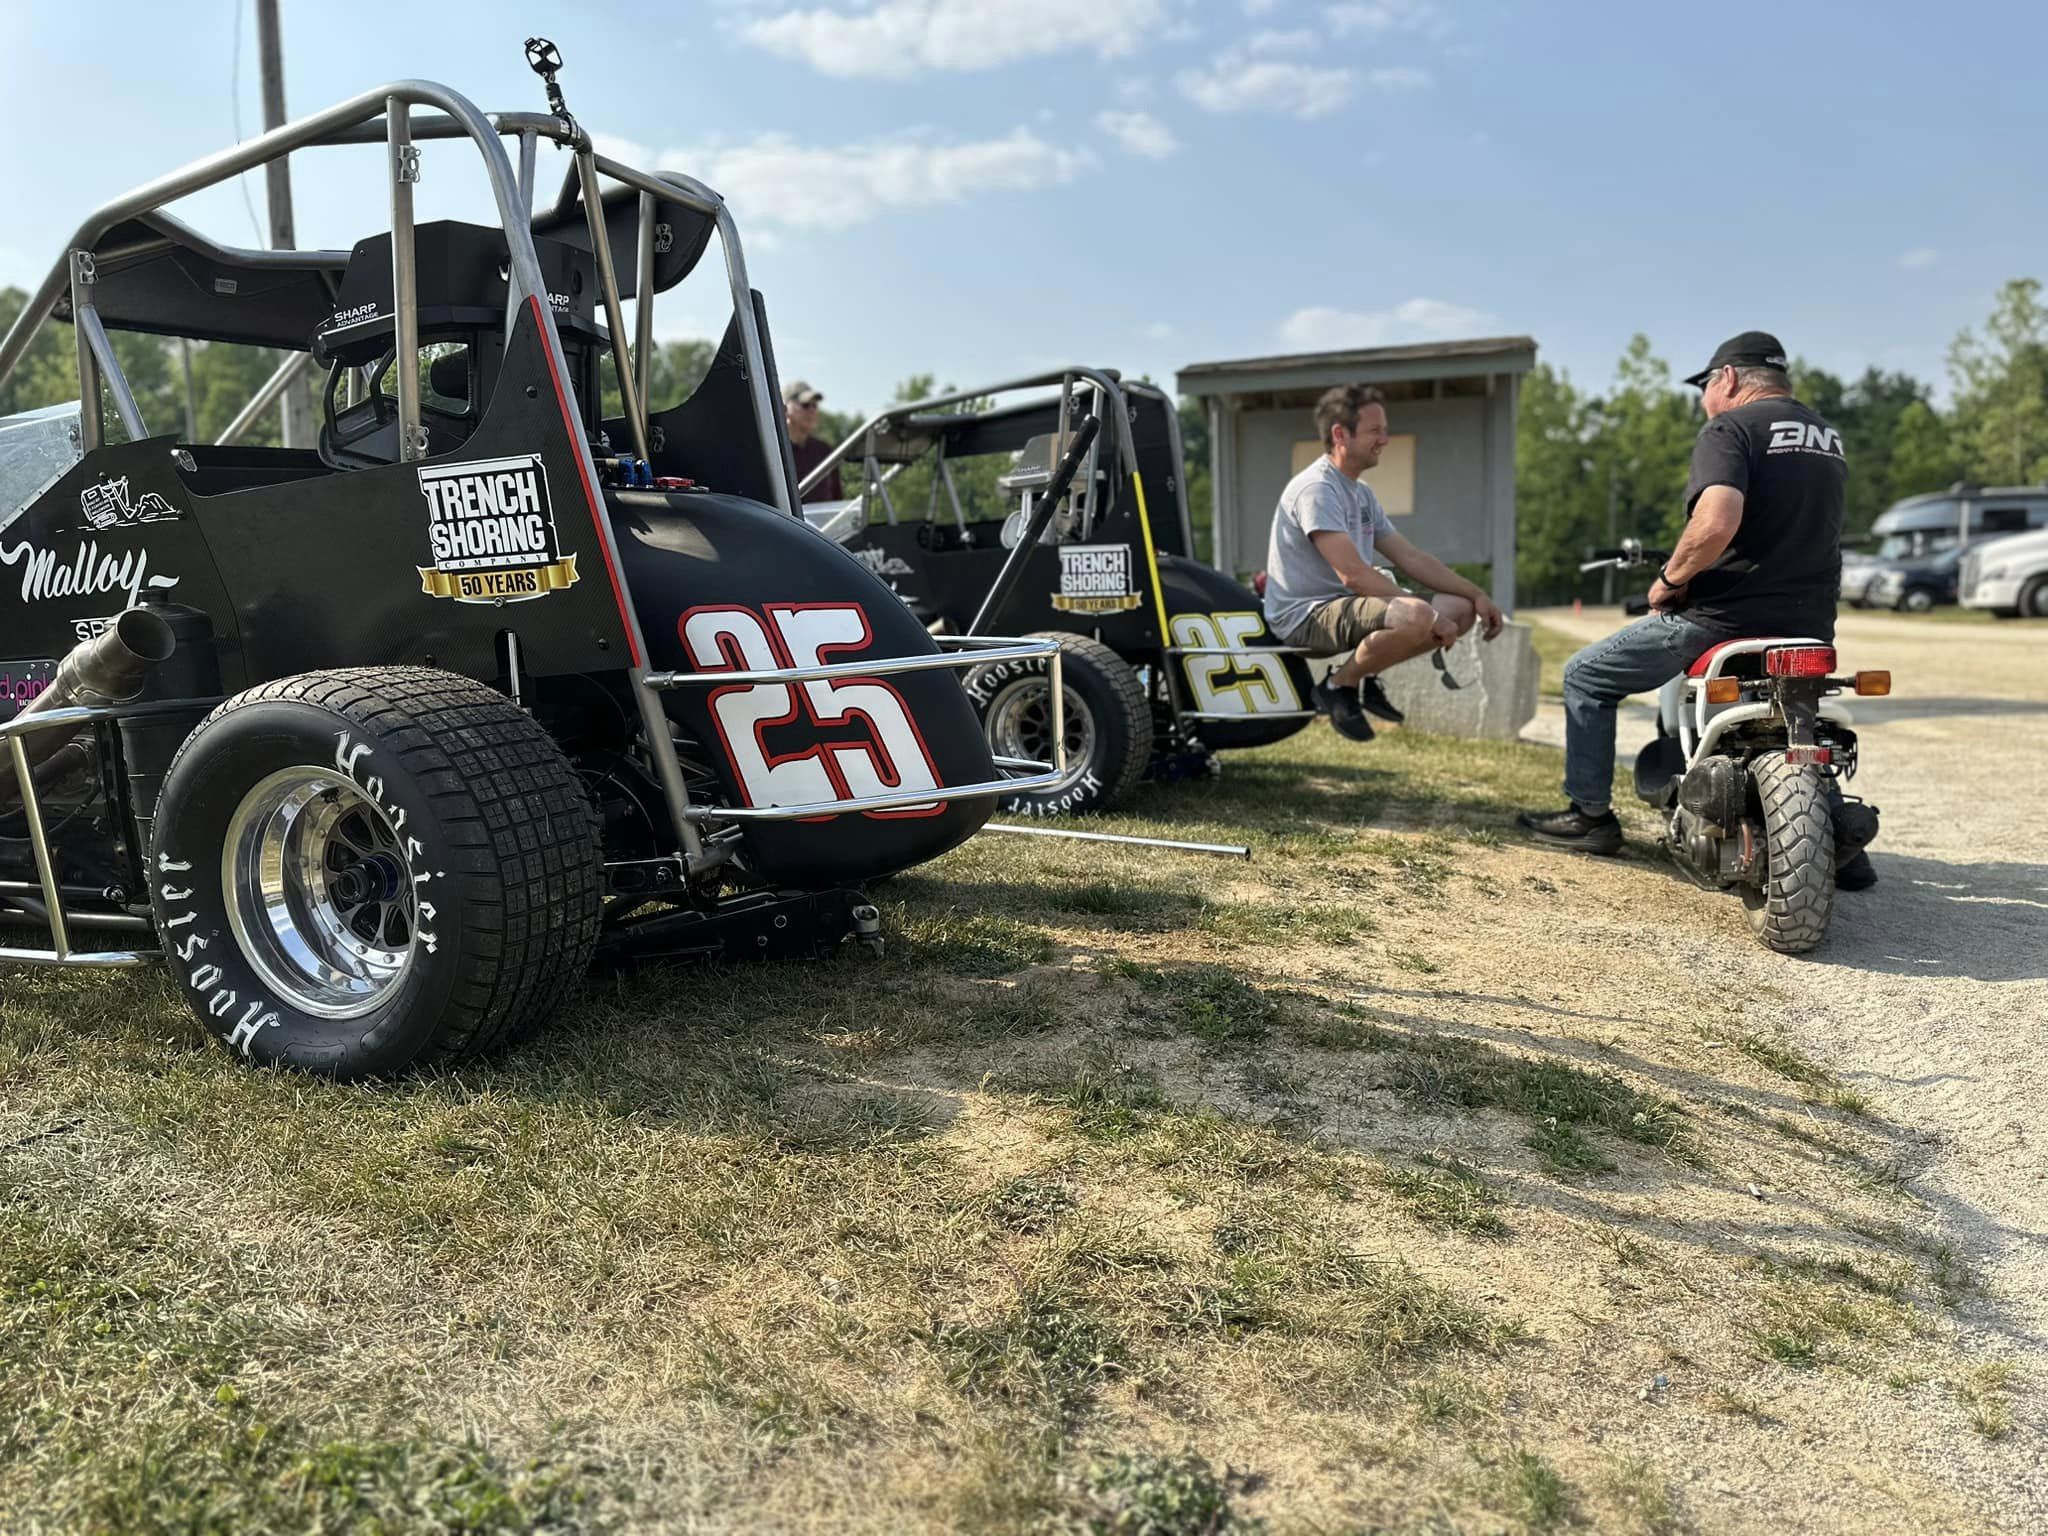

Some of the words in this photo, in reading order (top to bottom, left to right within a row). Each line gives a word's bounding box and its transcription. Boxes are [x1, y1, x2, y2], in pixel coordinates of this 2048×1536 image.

[334, 303, 377, 322] SHARP
[336, 311, 379, 328] ADVANTAGE
[423, 471, 541, 521] TRENCH
[432, 514, 546, 559] SHORING
[0, 540, 147, 609] Malloy
[444, 553, 543, 569] COMPANY
[1060, 552, 1126, 574] TRENCH
[461, 576, 483, 596] 50
[484, 571, 537, 593] YEARS
[1062, 572, 1127, 592] SHORING
[1089, 599, 1118, 610] YEARS
[1169, 612, 1303, 722] 25
[677, 602, 949, 823] 25
[1007, 767, 1103, 817] Hoosier
[158, 851, 281, 1057] Hoosier
